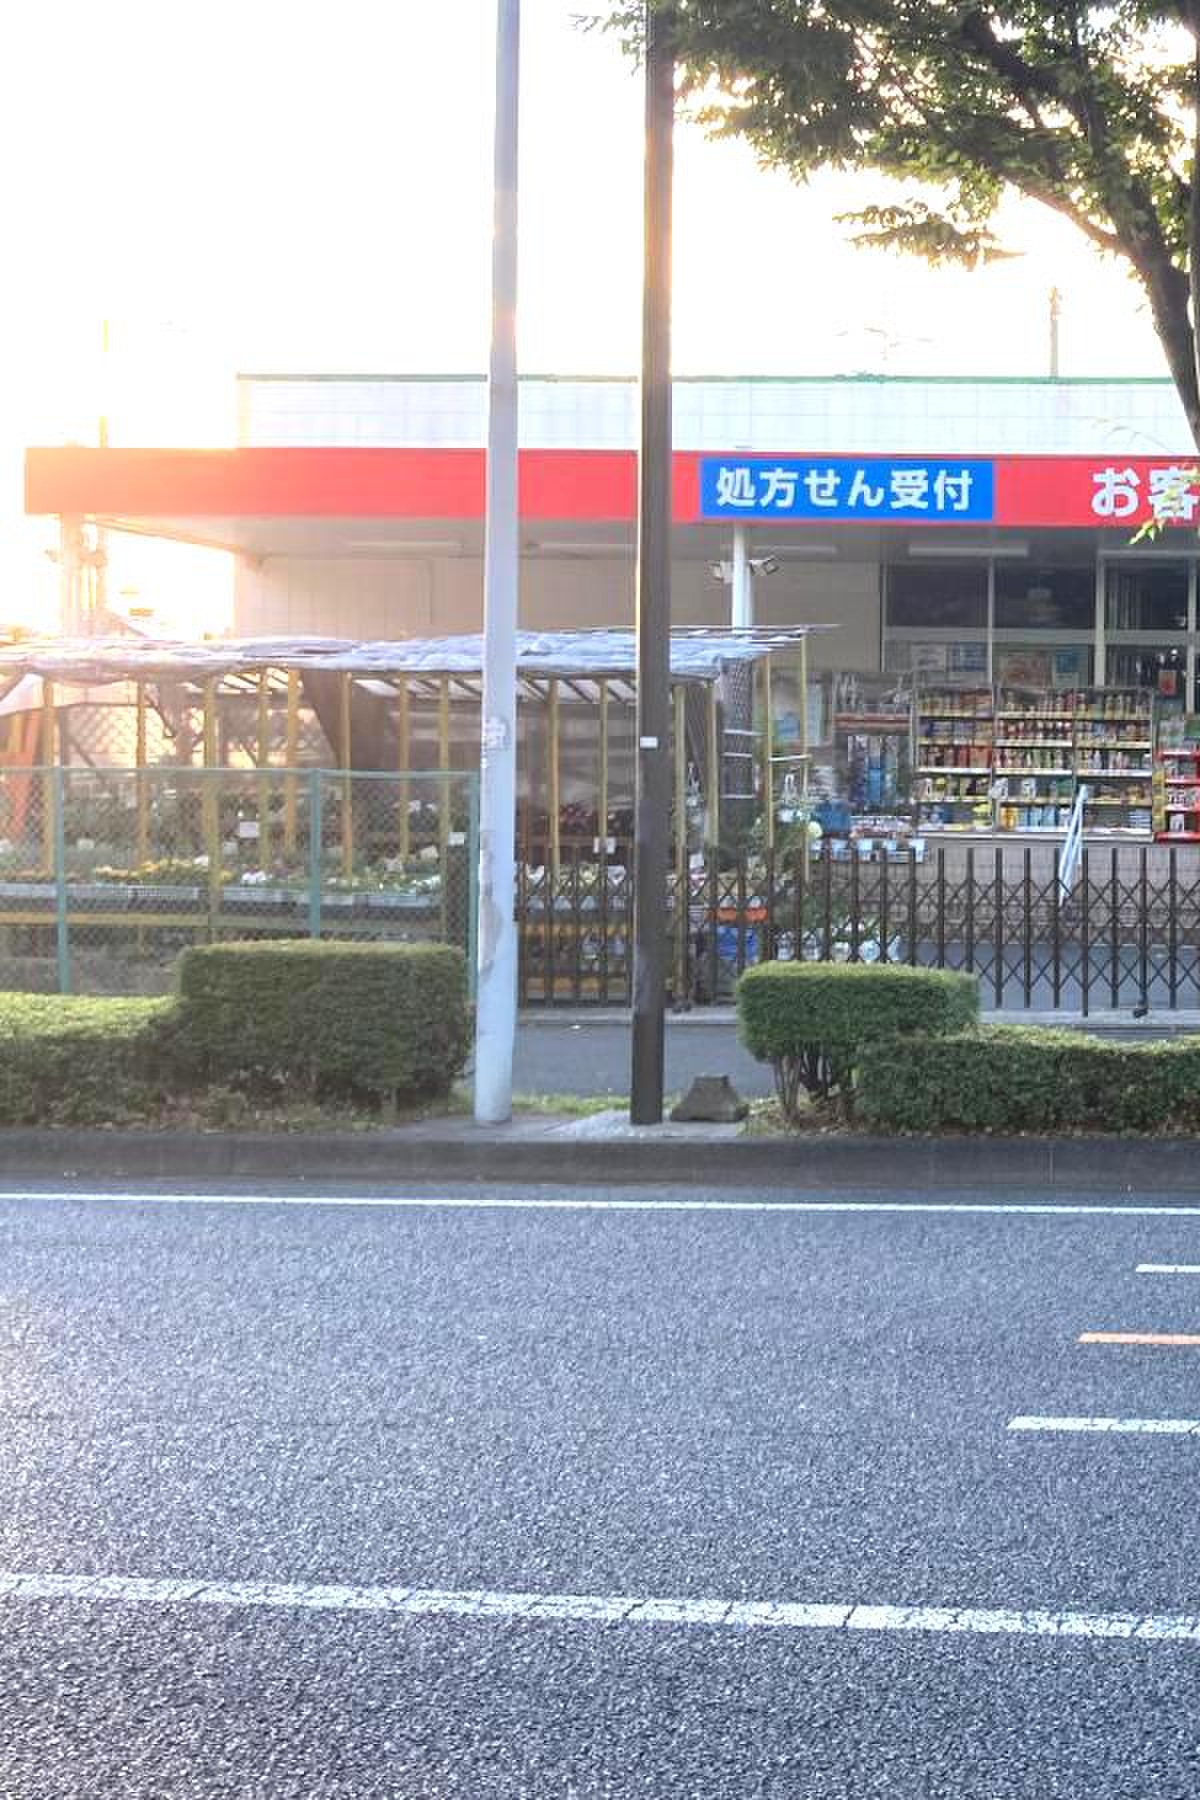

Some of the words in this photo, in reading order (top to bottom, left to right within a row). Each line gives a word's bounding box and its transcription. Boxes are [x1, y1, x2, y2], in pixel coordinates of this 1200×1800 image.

[716, 466, 974, 511] 処方せん受付
